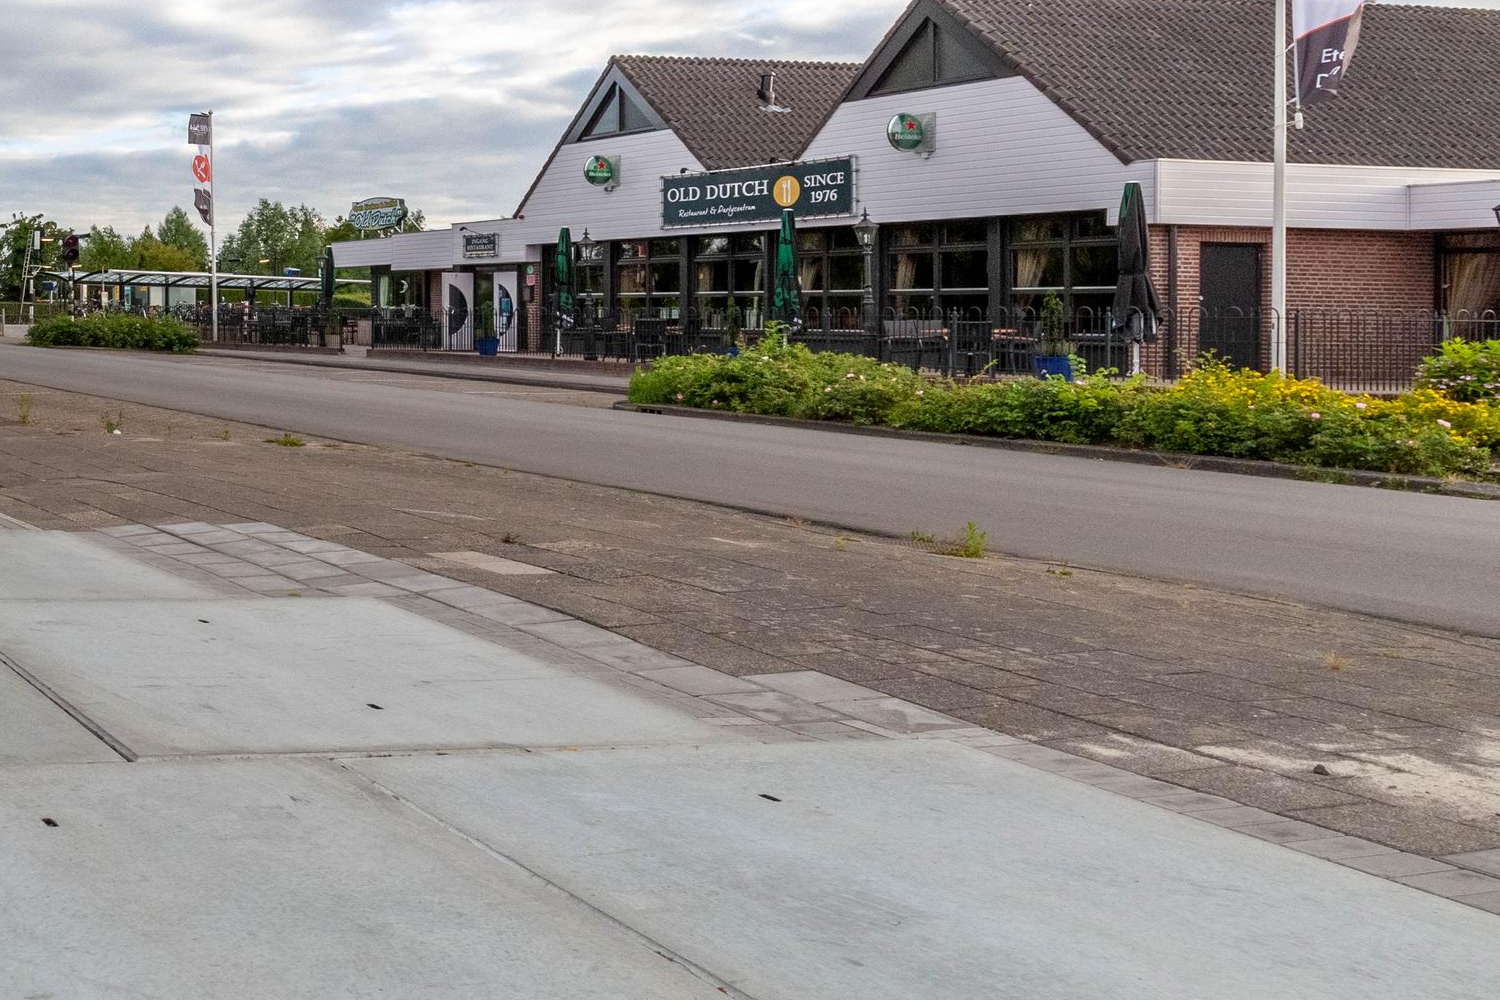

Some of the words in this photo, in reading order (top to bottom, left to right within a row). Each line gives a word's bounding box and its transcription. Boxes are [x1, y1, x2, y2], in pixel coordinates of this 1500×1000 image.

[803, 172, 845, 188] SINCE
[667, 186, 700, 203] OLD
[706, 179, 769, 200] DUTCH
[810, 189, 838, 204] 1976
[678, 207, 708, 218] Restaurant
[709, 206, 717, 215] &
[717, 204, 756, 217] Partycentrum
